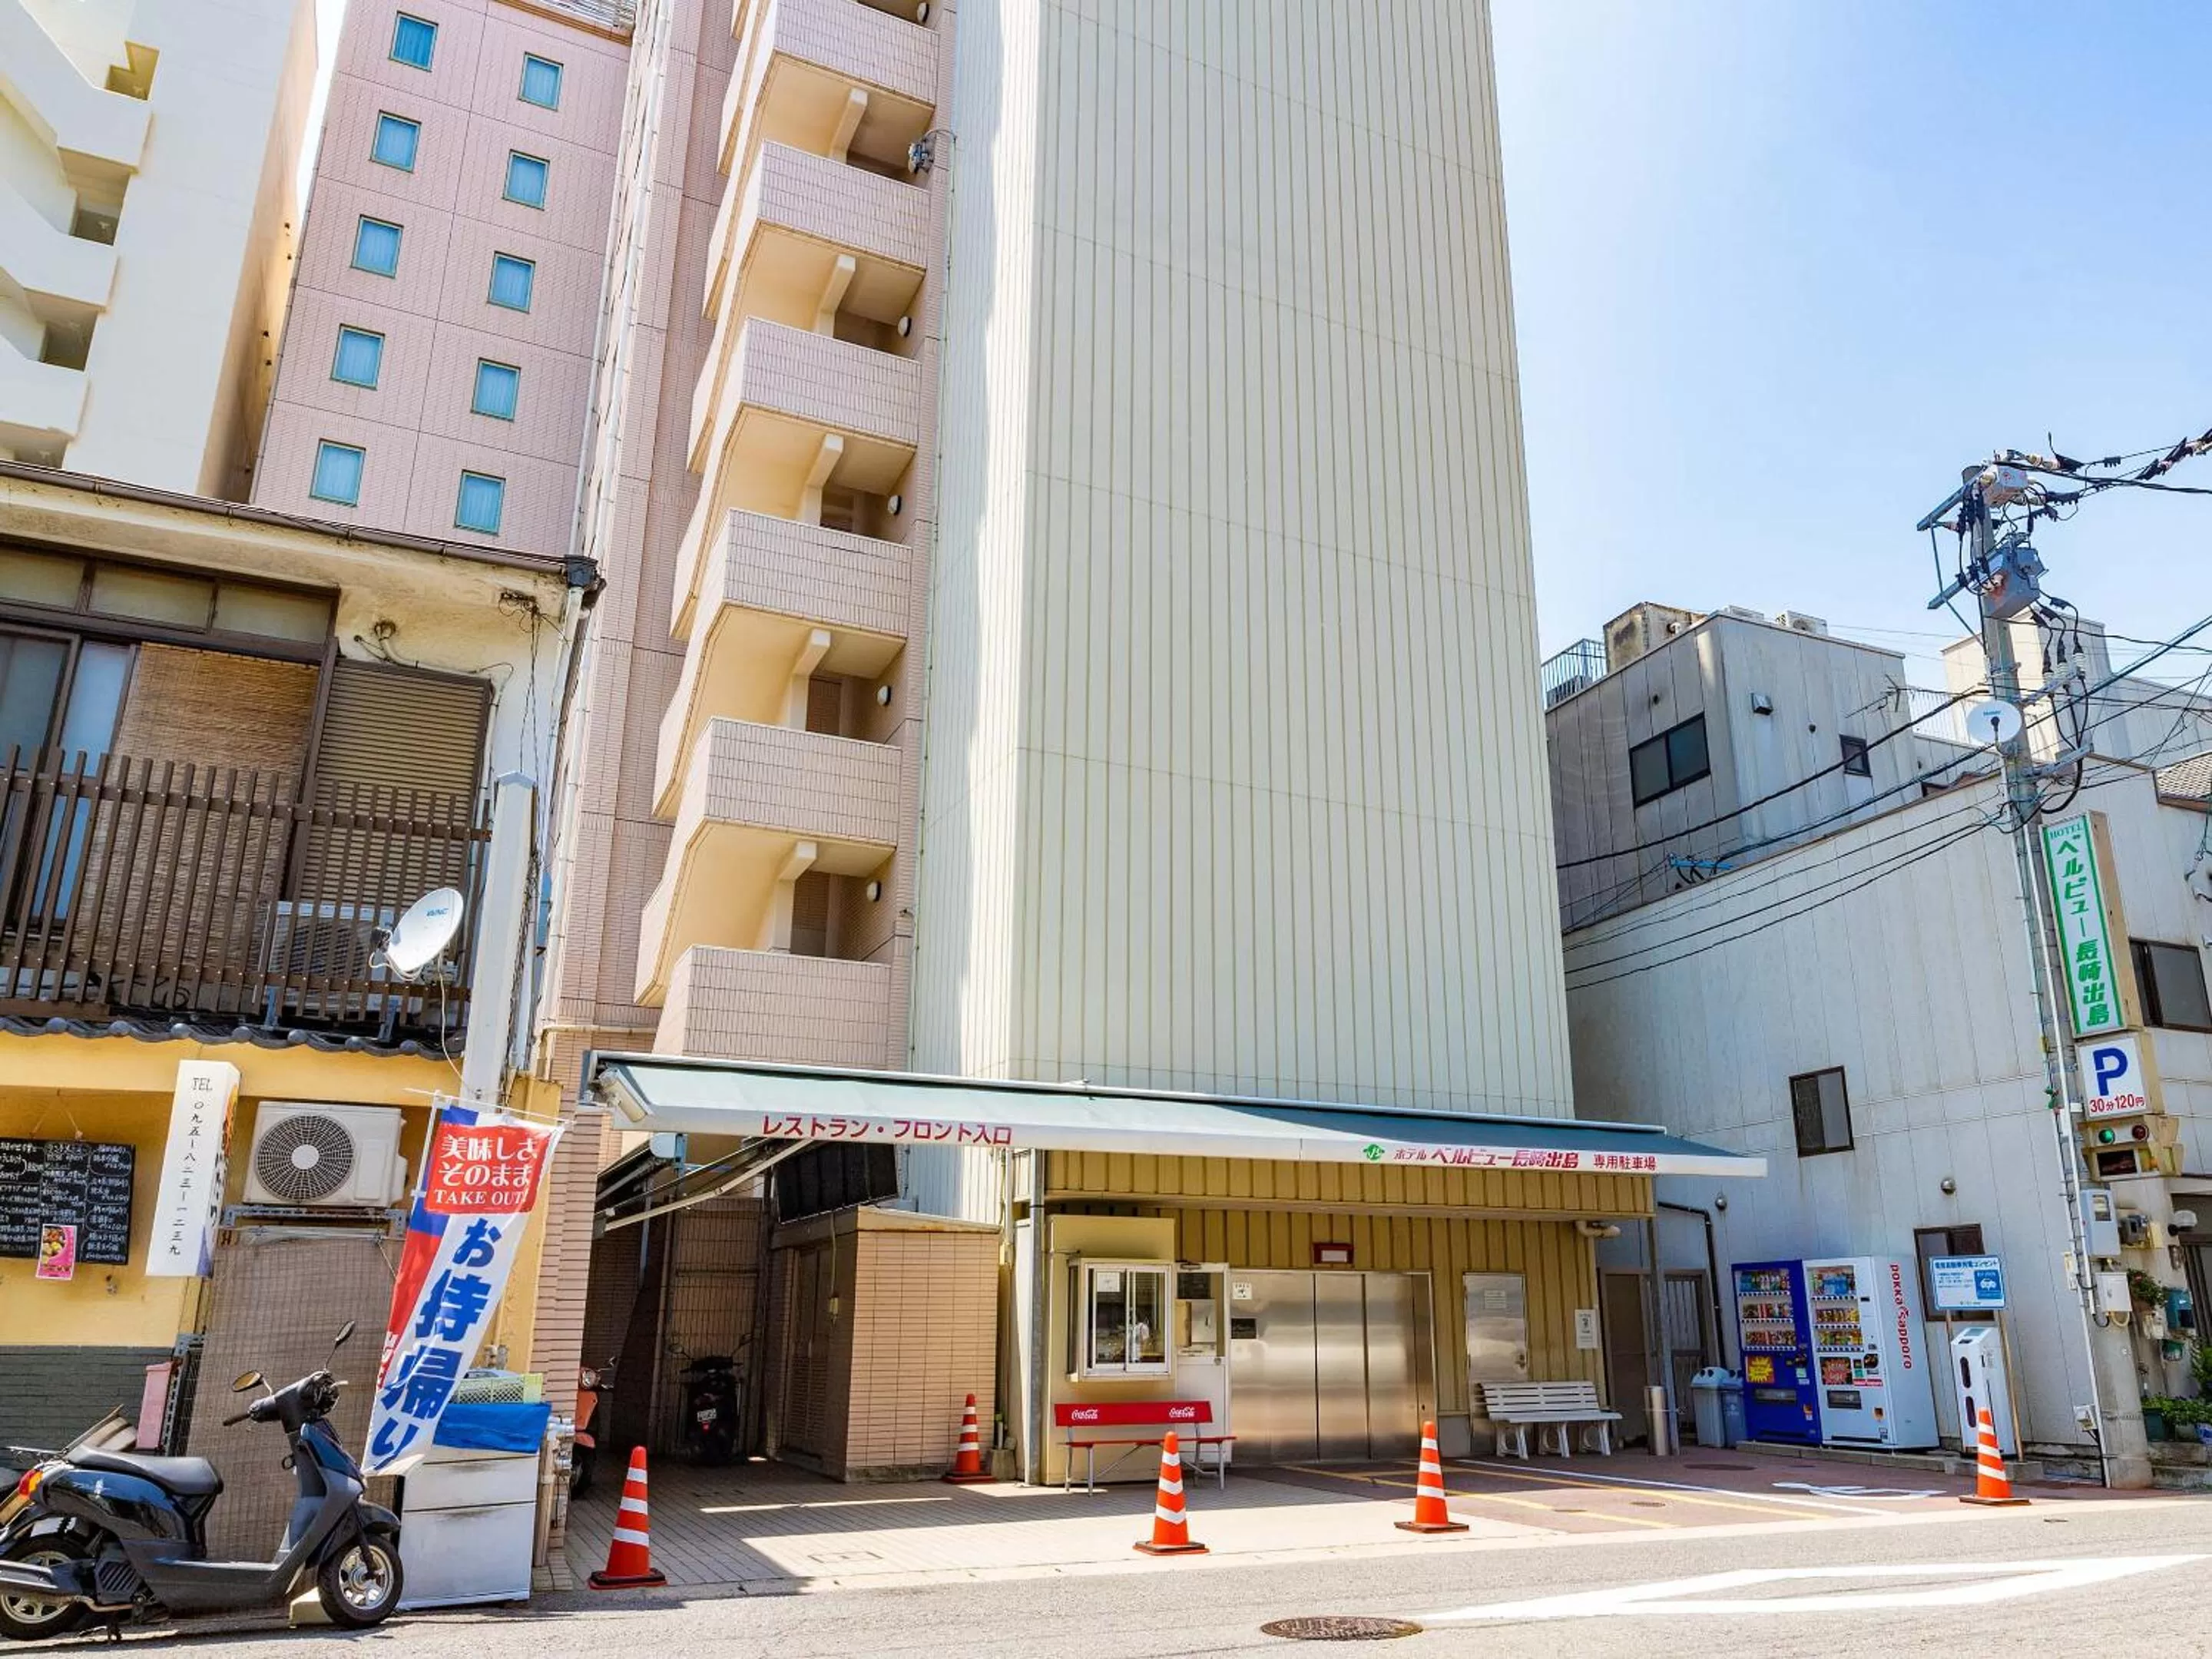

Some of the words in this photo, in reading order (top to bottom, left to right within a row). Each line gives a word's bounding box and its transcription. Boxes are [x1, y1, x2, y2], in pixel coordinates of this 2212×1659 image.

[2057, 833, 2110, 1027] ベルビュー長崎出島
[193, 1077, 213, 1091] TEL
[2093, 1048, 2128, 1096] P
[2089, 1094, 2145, 1113] 30分120円
[762, 1115, 1012, 1145] レストラン・フロント入口
[440, 1134, 538, 1161] 美味しさ
[1394, 1148, 1427, 1161] ホテル
[1594, 1154, 1657, 1171] 専用駐車場
[437, 1162, 533, 1187] そのまま
[434, 1188, 485, 1205] TAKE
[371, 1218, 502, 1470] お持帰り
